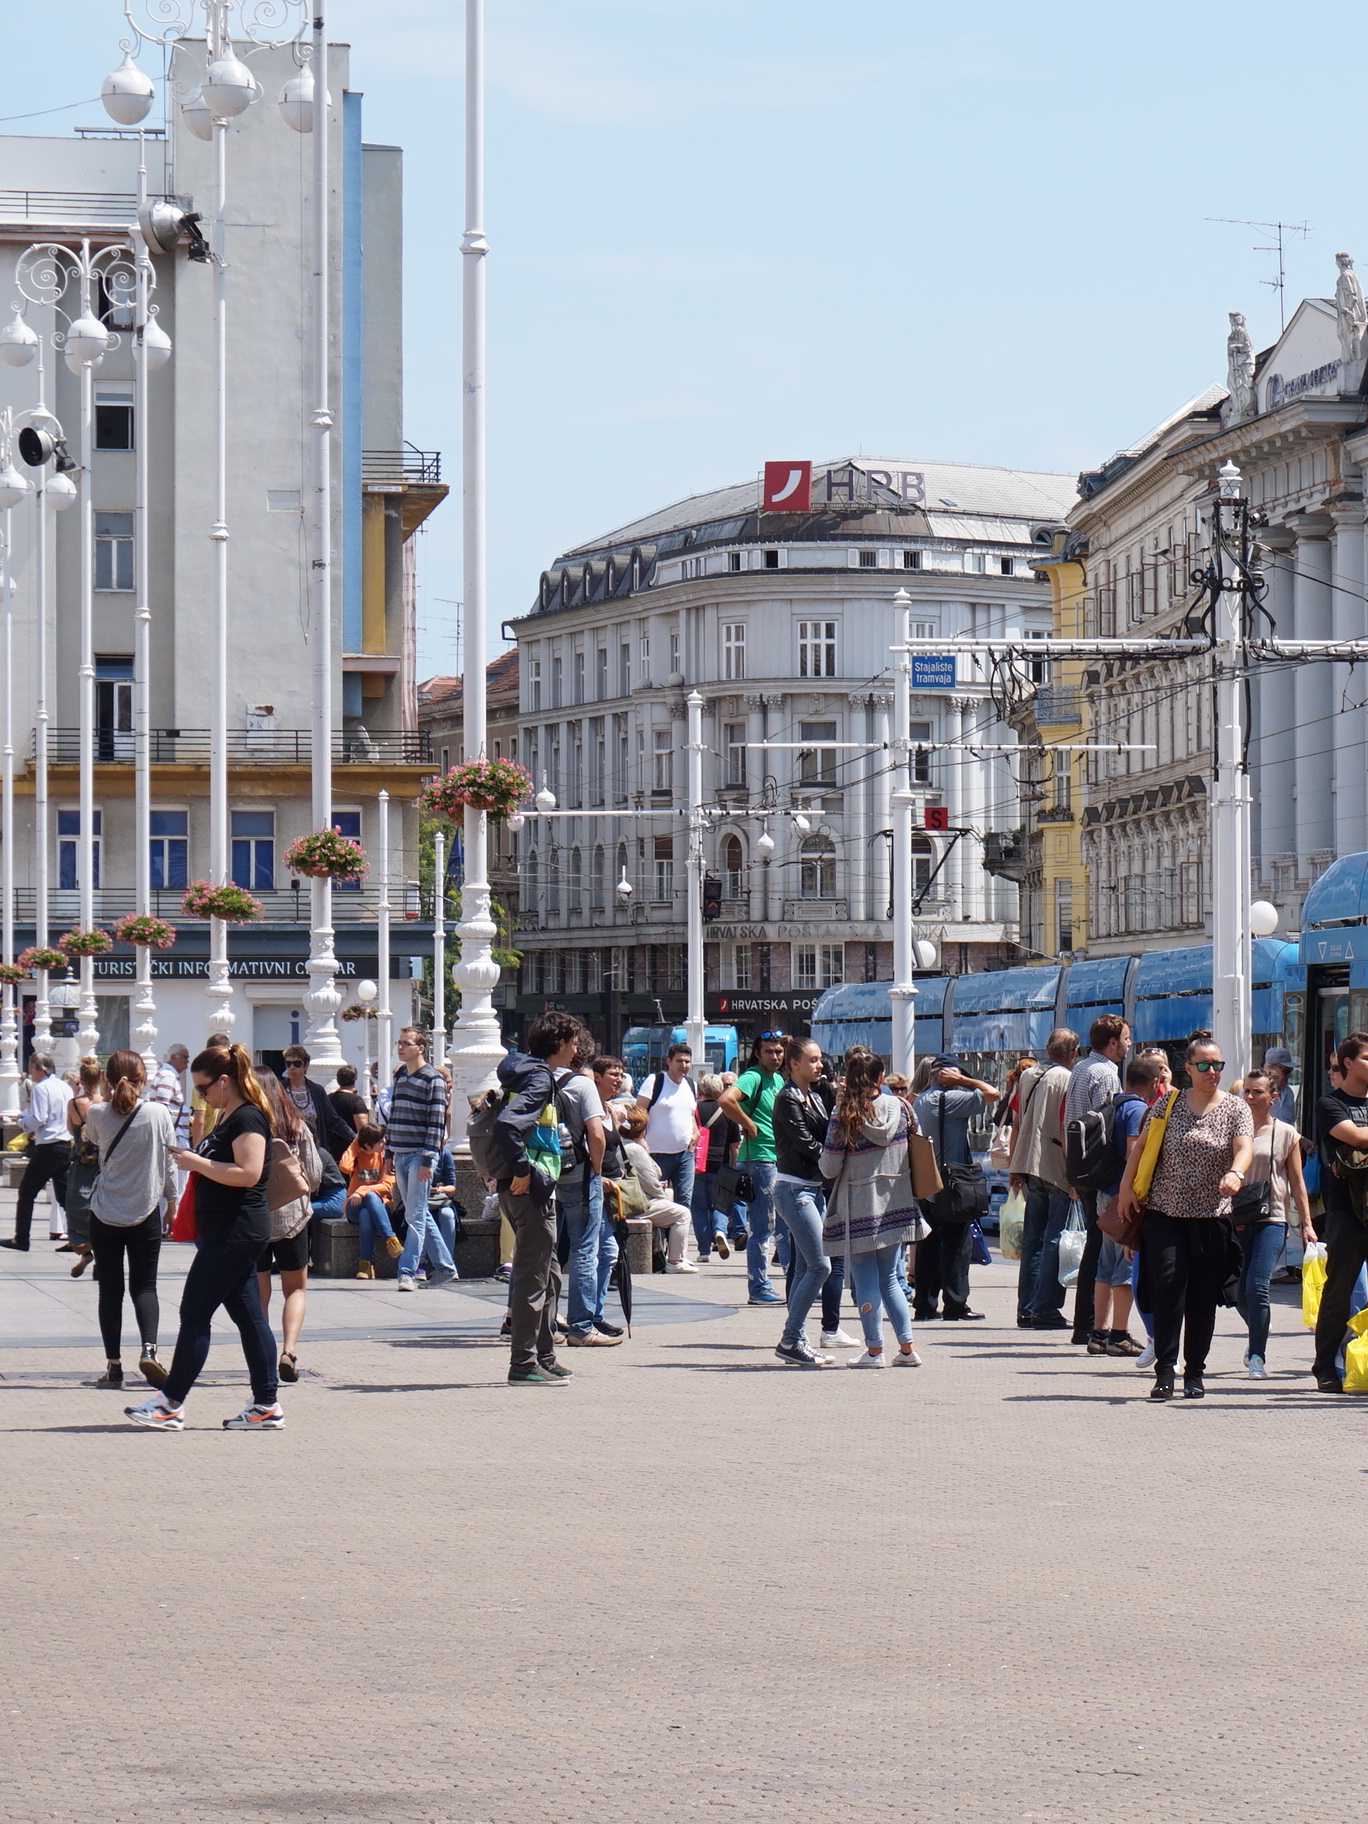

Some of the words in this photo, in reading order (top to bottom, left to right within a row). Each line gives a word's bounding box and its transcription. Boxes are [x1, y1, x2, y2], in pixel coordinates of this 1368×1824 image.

[916, 674, 952, 685] tramvaja
[930, 810, 942, 828] S
[706, 924, 767, 939] HRVATSKA
[93, 960, 173, 975] URISČKI
[178, 961, 291, 975] INFOMATIVNI
[295, 961, 356, 975] CAR
[731, 999, 788, 1010] HRVATSKA
